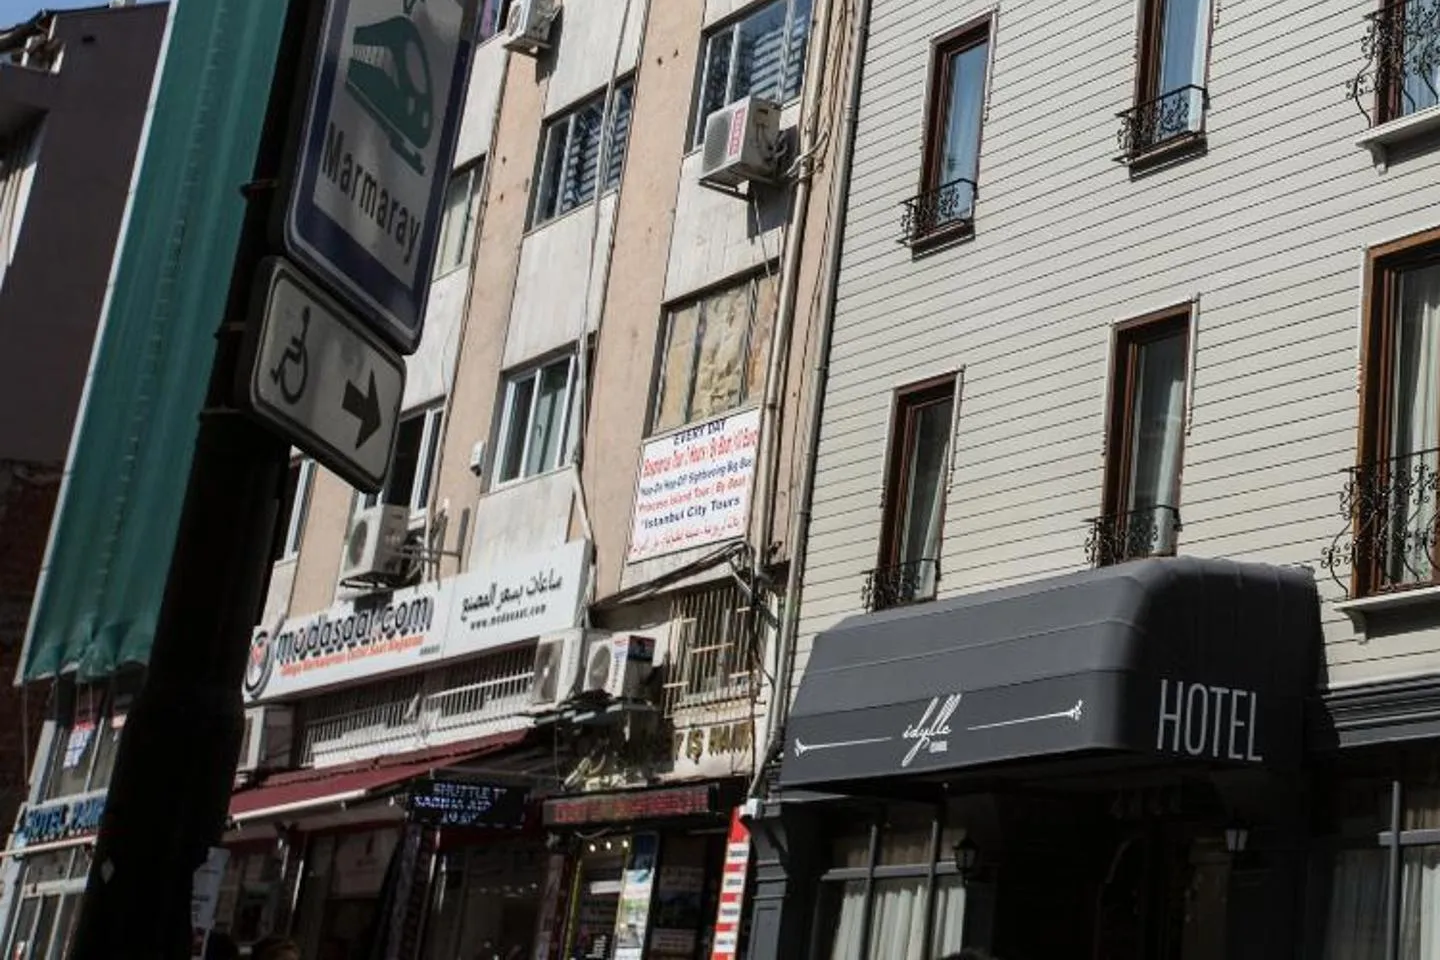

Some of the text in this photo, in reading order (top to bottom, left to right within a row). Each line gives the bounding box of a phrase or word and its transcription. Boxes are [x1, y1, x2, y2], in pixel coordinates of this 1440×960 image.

[322, 121, 421, 265] Marmaray
[673, 420, 726, 446] EVERY DAY
[686, 504, 707, 518] City
[711, 495, 740, 512] Tours
[902, 693, 962, 768] idylle
[1155, 678, 1263, 762] HOTEL
